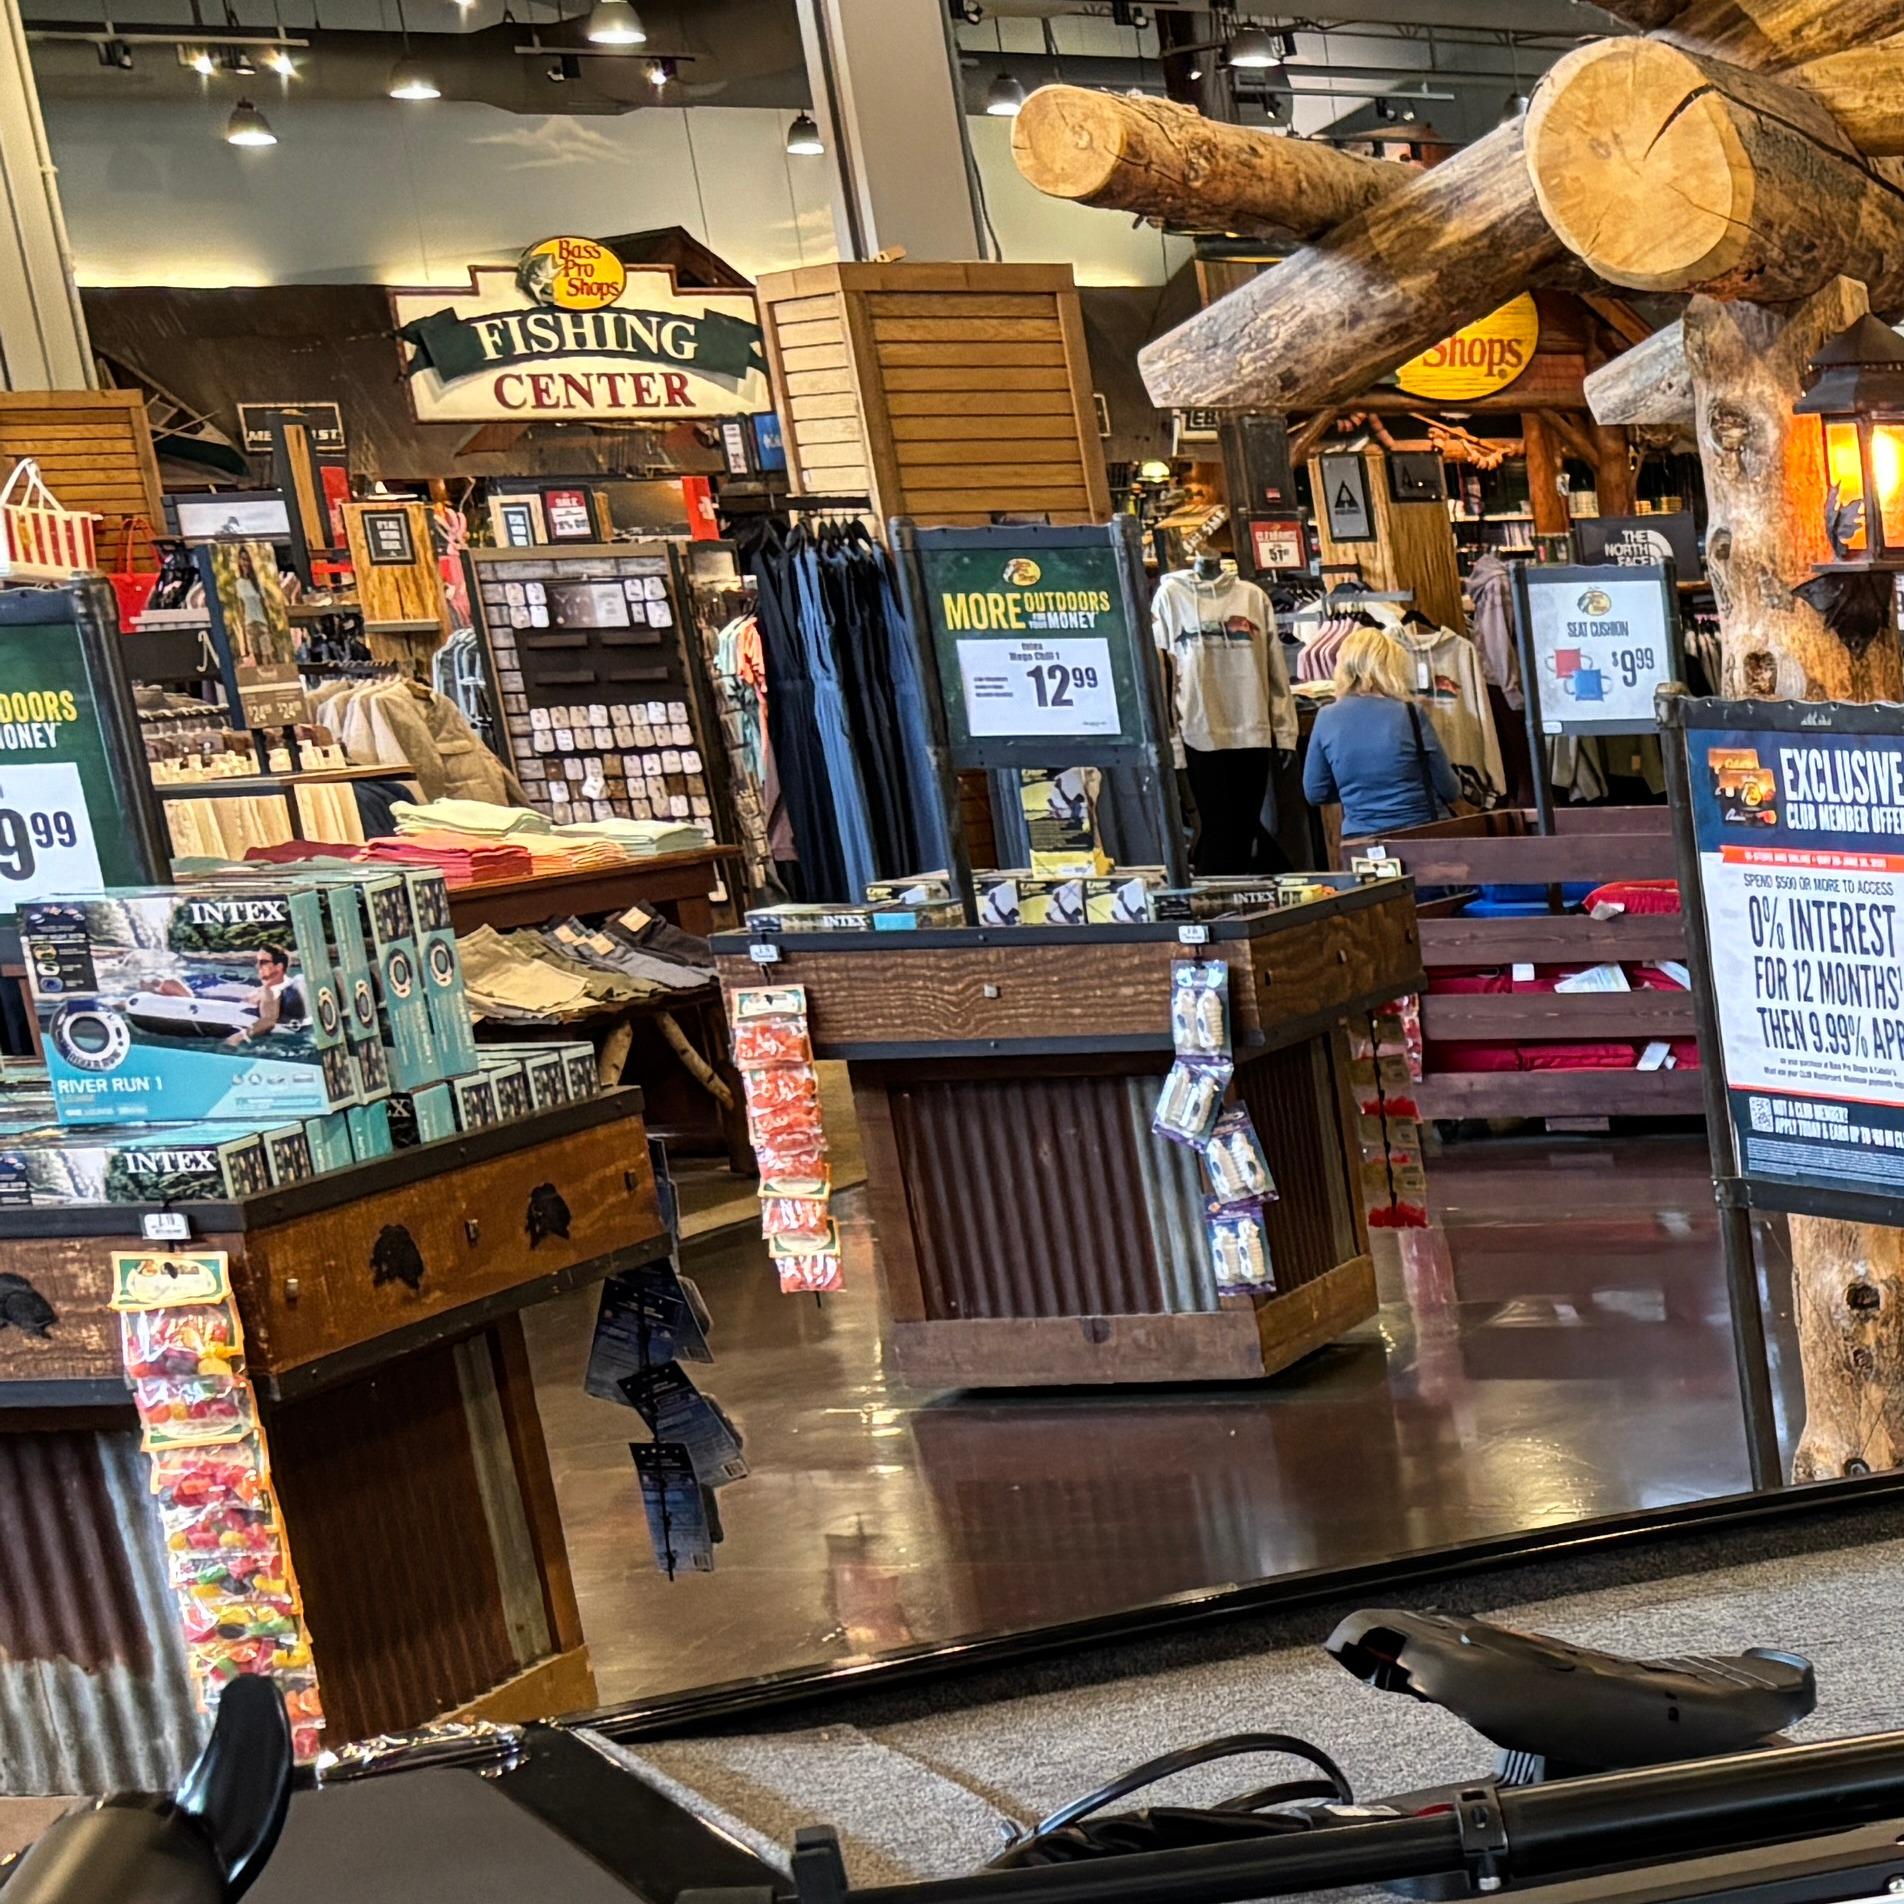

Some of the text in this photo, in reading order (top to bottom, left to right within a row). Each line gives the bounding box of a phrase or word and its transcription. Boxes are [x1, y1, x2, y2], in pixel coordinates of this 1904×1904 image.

[559, 240, 601, 260] Bass
[563, 260, 595, 277] Pro
[566, 278, 620, 300] Shops
[478, 312, 698, 362] FISHING
[494, 371, 697, 410] CENTER
[1622, 530, 1649, 544] THE
[1604, 544, 1649, 557] NORTH
[942, 590, 1111, 630] MORE OUTDOORS
[1047, 611, 1097, 629] MONEY
[1567, 620, 1630, 638] SEAT CUSHION
[1785, 802, 1817, 831] CLUB
[1818, 803, 1870, 834] MEMBER
[1744, 873, 1895, 897] SPEND $500 OR MORE TO ACCESS
[1232, 890, 1276, 905] INTEX
[191, 901, 287, 924] INTEX
[822, 912, 869, 929] INTEX
[1749, 895, 1896, 958] 0% INTEREST
[1754, 955, 1790, 1001] FOR
[1792, 959, 1814, 1003] 12
[1756, 1006, 1808, 1051] THEN
[1808, 1011, 1869, 1059] 9.99%
[57, 1075, 108, 1095] RIVER
[111, 1075, 150, 1094] RUN
[124, 1150, 218, 1173] INTEX
